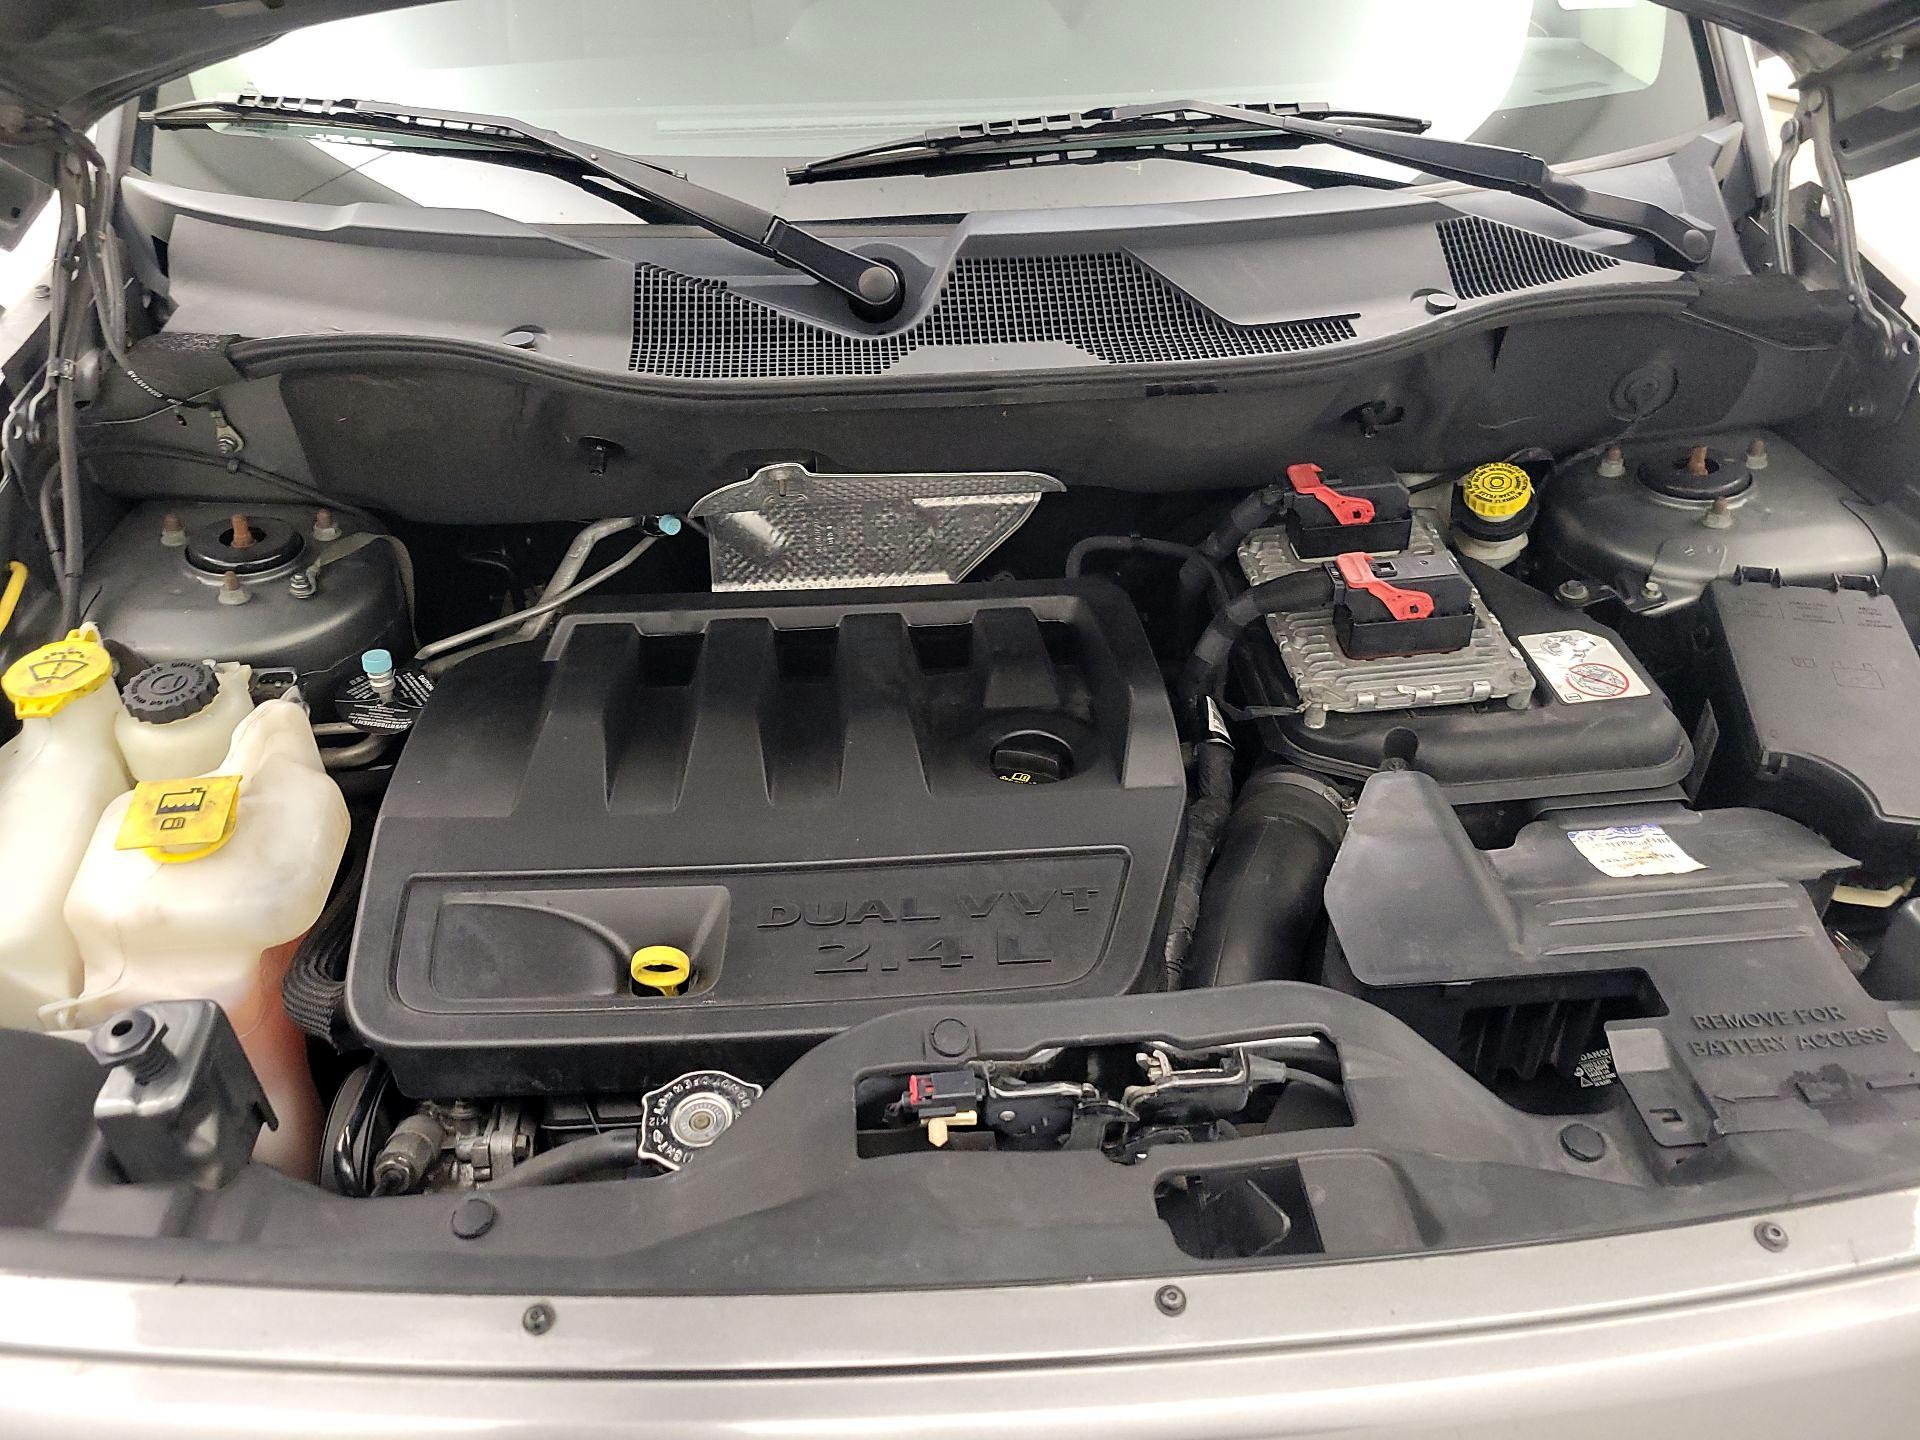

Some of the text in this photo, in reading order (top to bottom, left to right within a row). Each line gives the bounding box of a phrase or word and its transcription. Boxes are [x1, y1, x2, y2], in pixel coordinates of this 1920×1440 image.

[756, 887, 1100, 929] DUAL VVT
[1691, 1005, 1847, 1032] REMOVE FOR
[1686, 1026, 1890, 1058] BATTERY ACCESS
